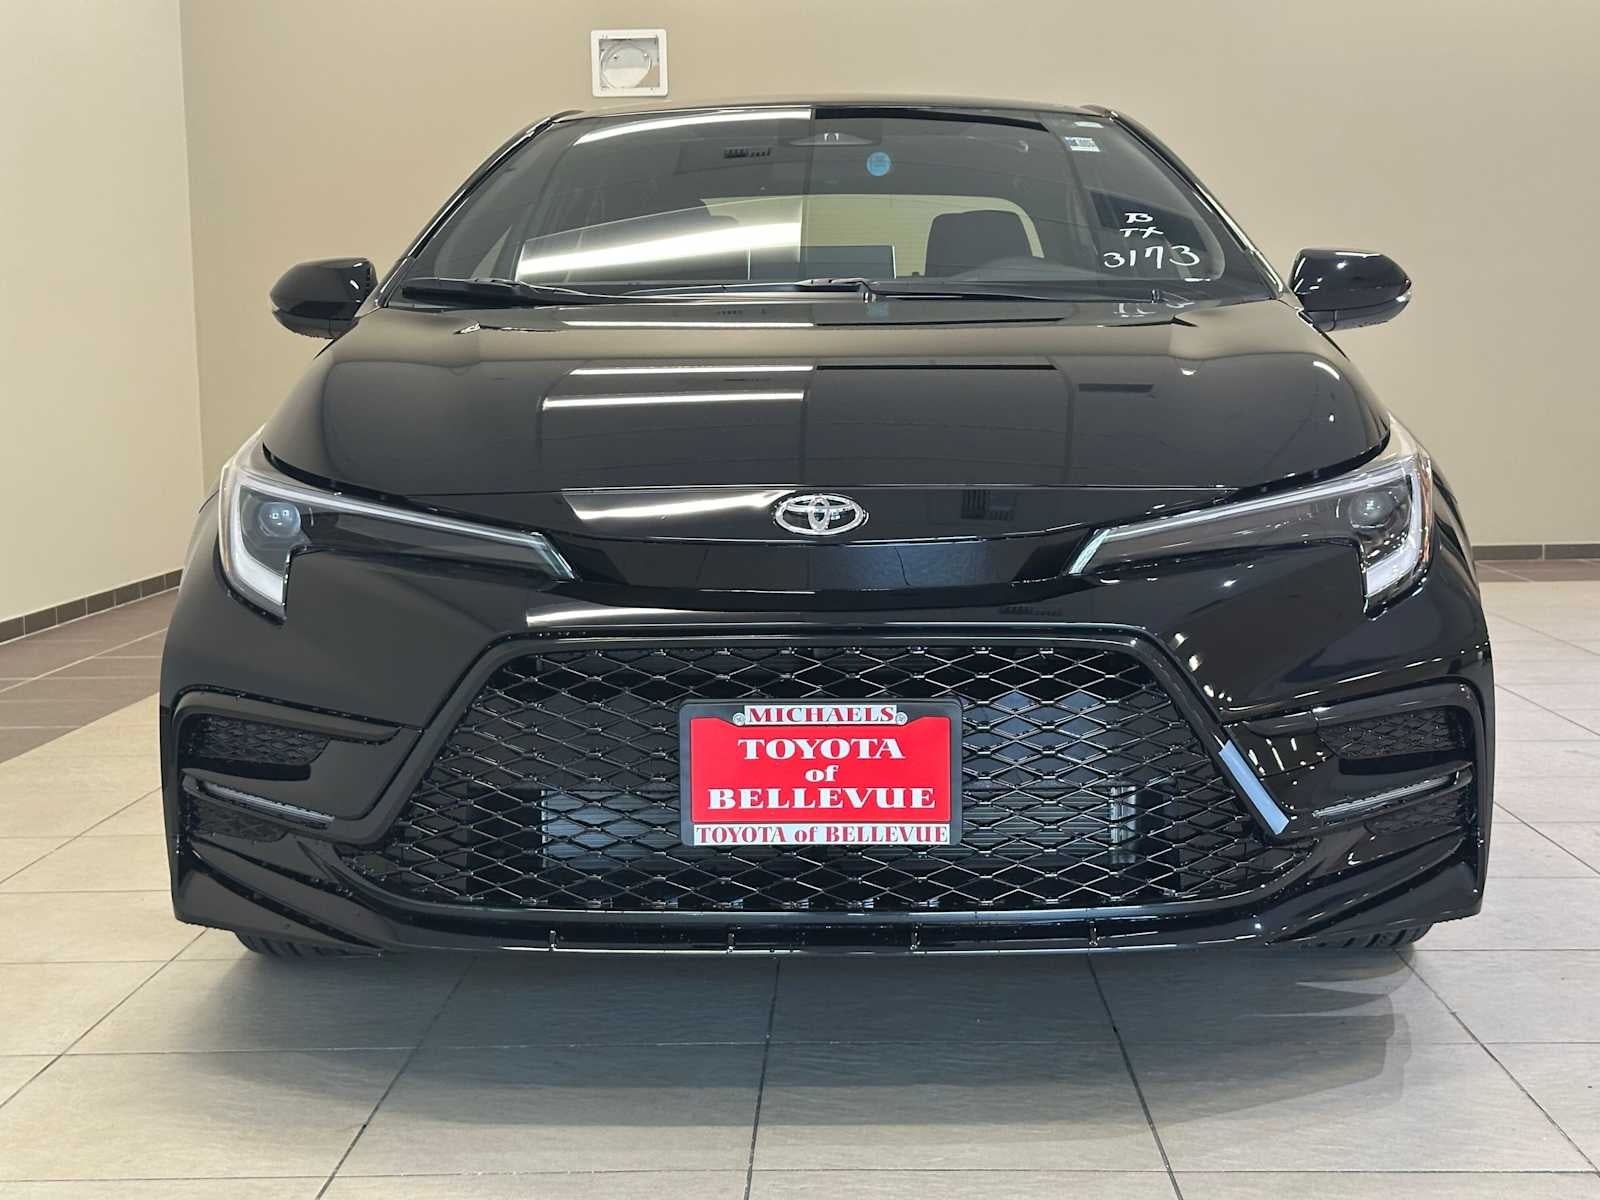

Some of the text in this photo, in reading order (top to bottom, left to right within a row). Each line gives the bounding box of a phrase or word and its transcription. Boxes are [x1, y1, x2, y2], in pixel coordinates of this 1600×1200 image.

[1103, 245, 1201, 269] 3173
[749, 706, 895, 723] MICHAELS
[737, 738, 905, 760] TOYOTA
[804, 764, 840, 783] of
[706, 787, 936, 810] BELLEVUE
[696, 825, 948, 844] TOYOTA of BELLEVUE
